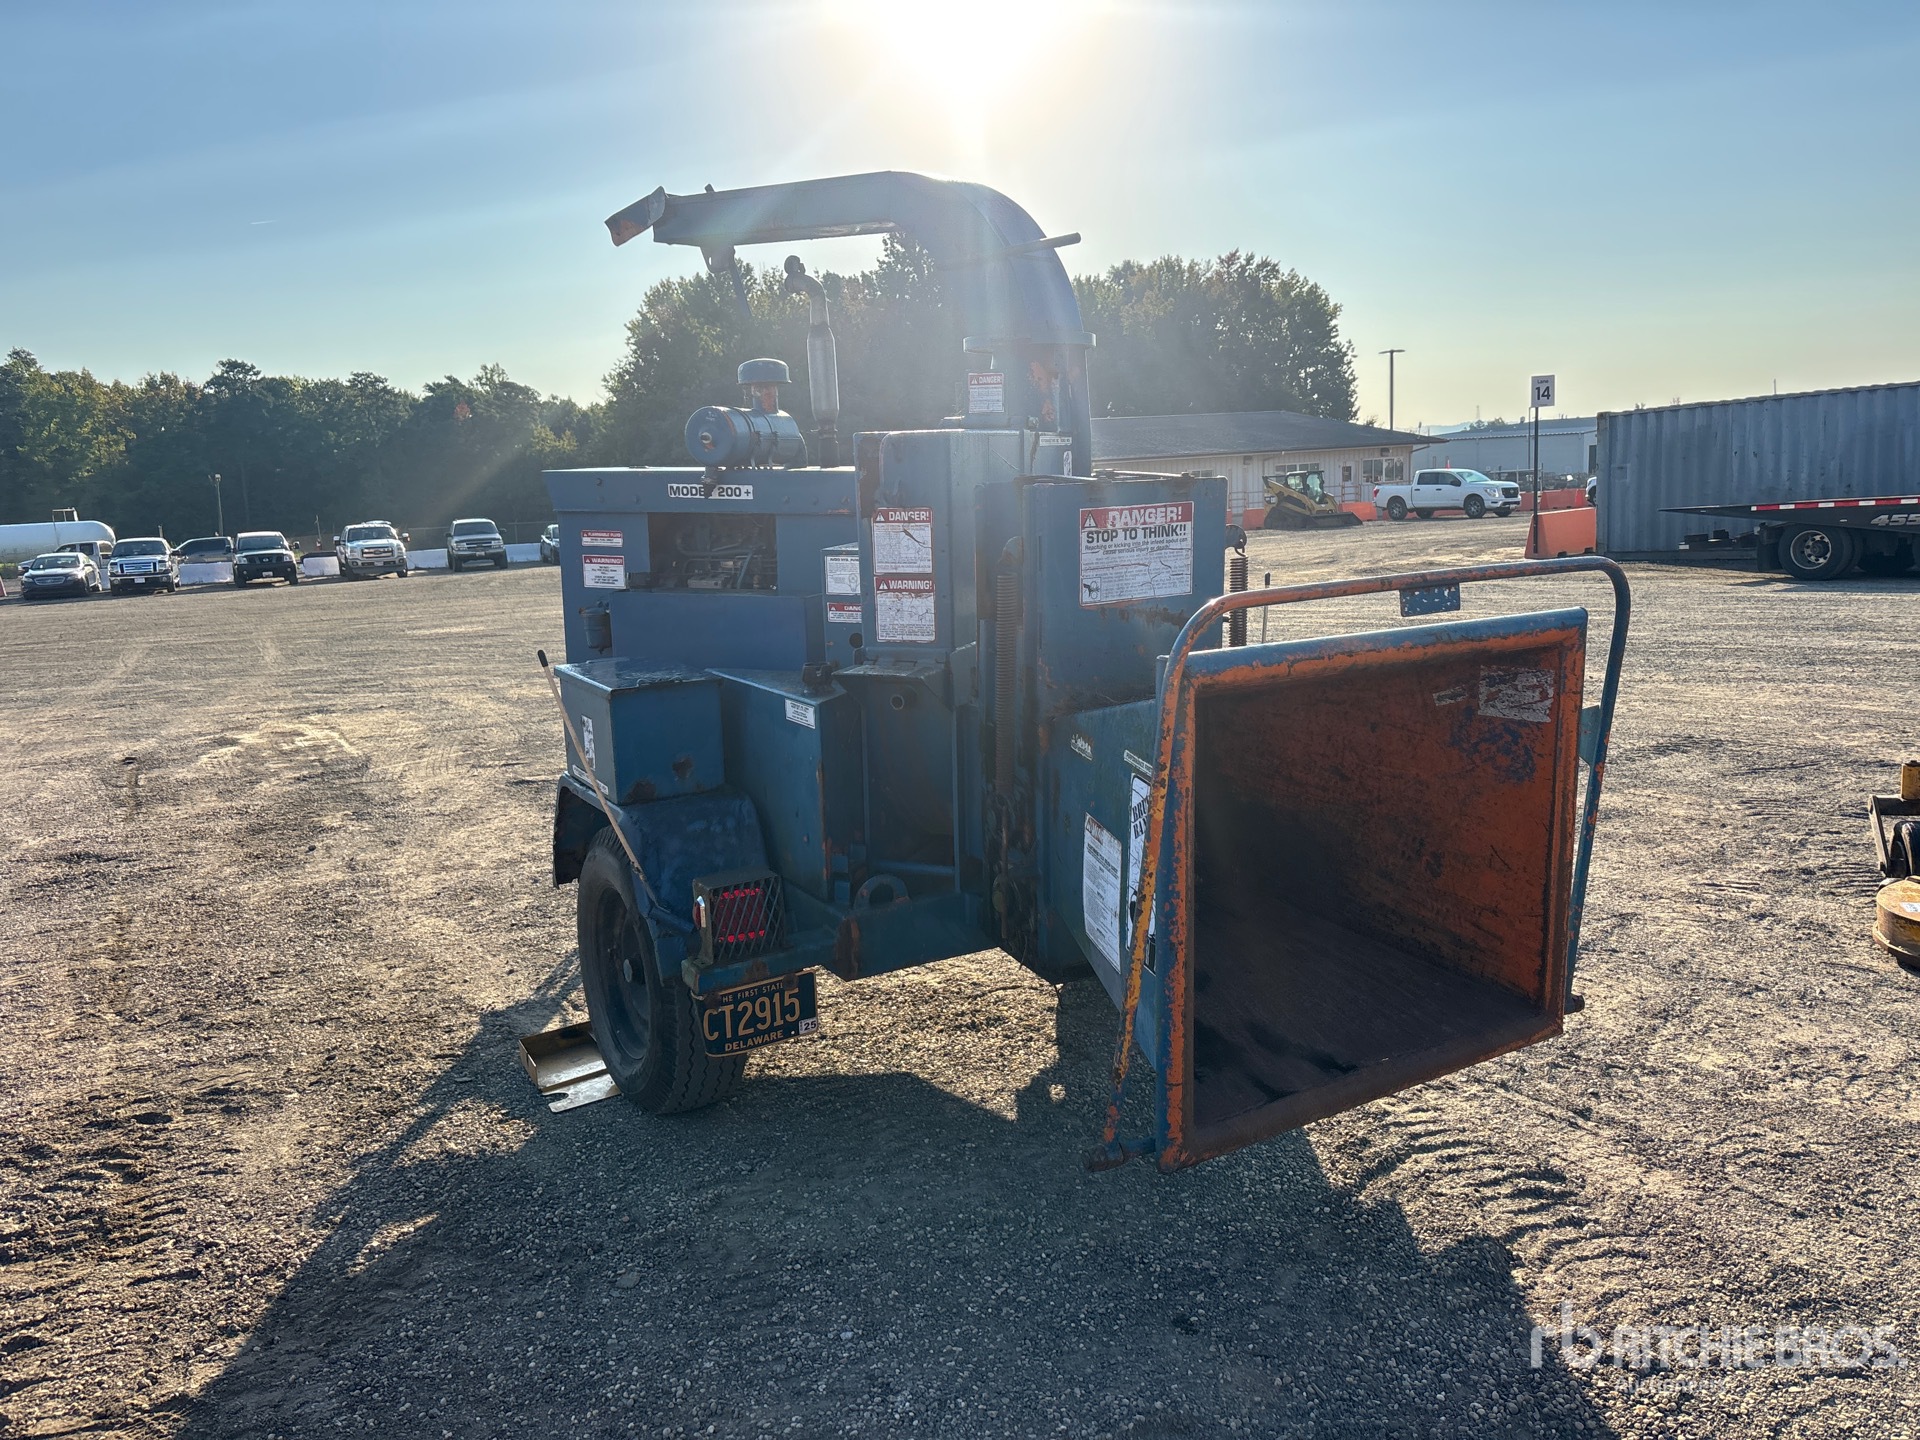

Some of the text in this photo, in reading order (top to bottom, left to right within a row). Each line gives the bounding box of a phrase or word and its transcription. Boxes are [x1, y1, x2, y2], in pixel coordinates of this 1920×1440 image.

[1535, 386, 1551, 400] 14
[669, 485, 706, 497] MODE
[888, 511, 930, 521] DANGER!
[1108, 506, 1182, 528] DANGER!
[1086, 523, 1187, 544] STOP TO THINK!!
[1084, 543, 1108, 552] Reaching
[1114, 541, 1131, 549] kicking
[888, 580, 932, 590] WARNING!
[1132, 798, 1148, 821] BRU
[1133, 816, 1148, 840] BAN
[722, 994, 734, 1003] HE
[737, 988, 759, 1000] FIRST
[703, 987, 801, 1042] CT2915
[804, 1020, 817, 1032] 25
[724, 1030, 784, 1051] DELAWARE
